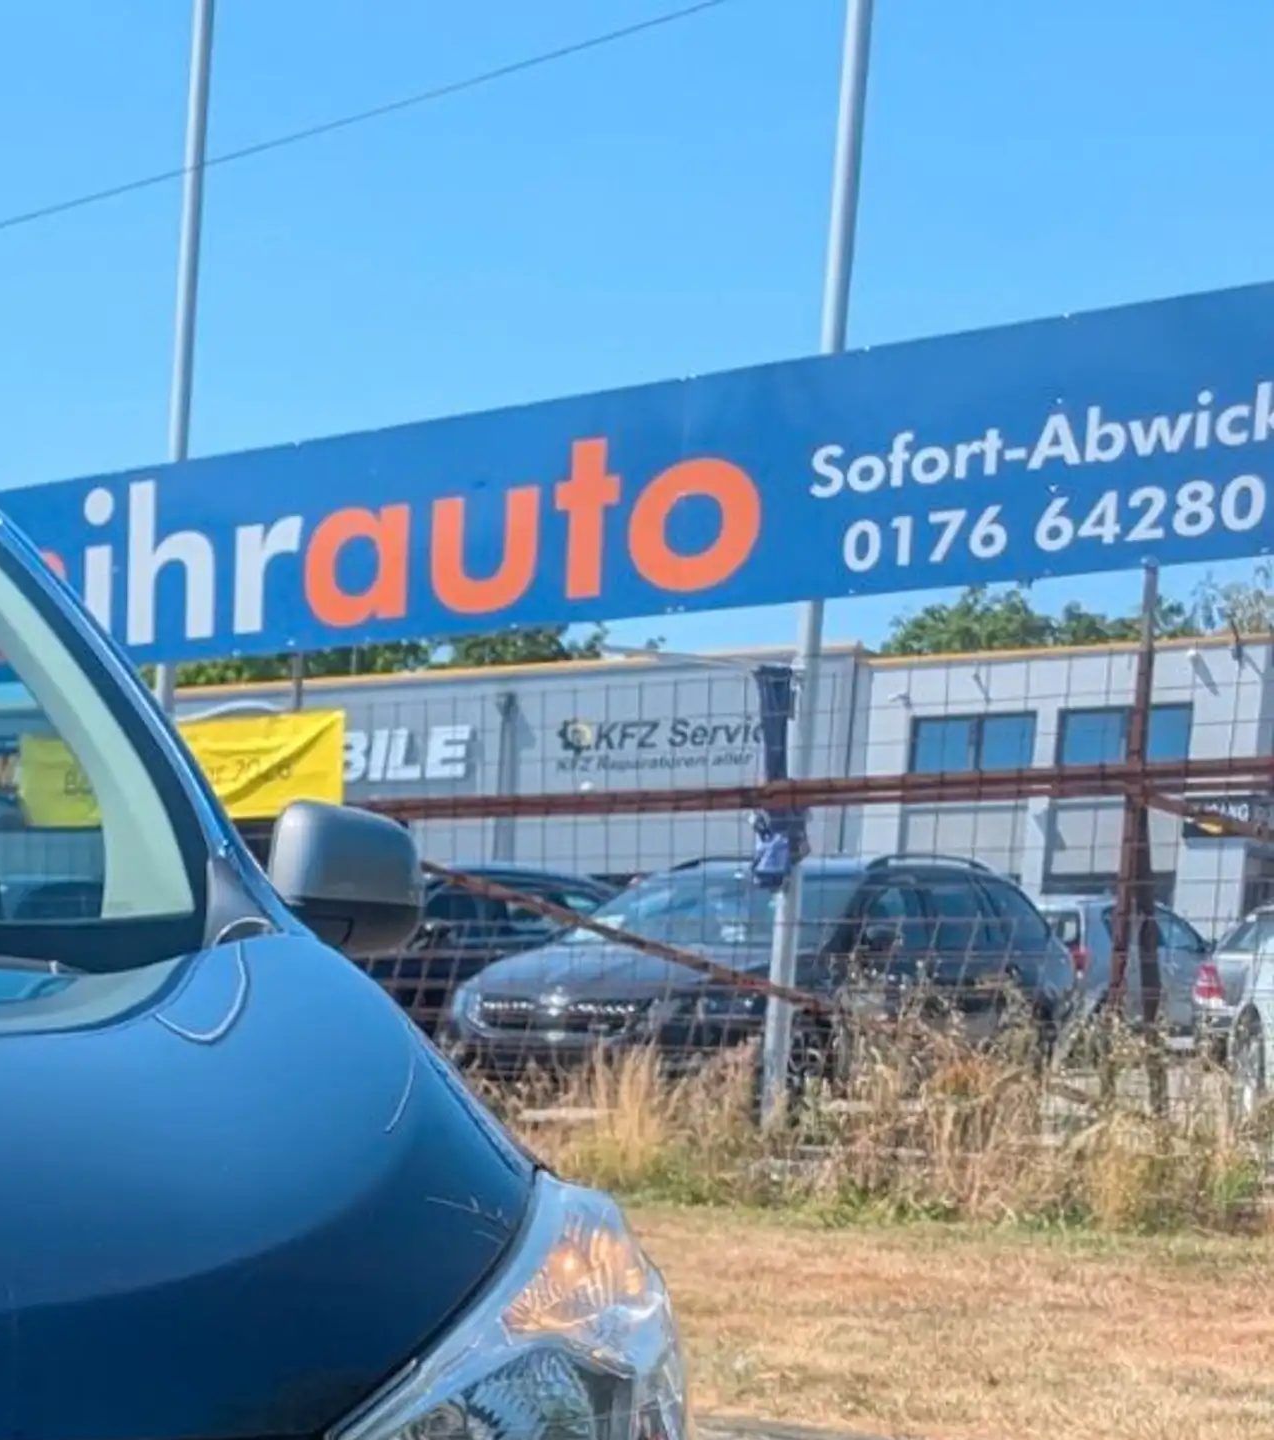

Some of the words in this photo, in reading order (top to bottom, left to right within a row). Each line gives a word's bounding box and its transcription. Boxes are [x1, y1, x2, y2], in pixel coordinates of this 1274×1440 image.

[809, 381, 1274, 499] Sofort-Abwick
[842, 504, 1008, 573] 0176
[1033, 474, 1266, 553] 64280
[594, 719, 660, 752] KFZ
